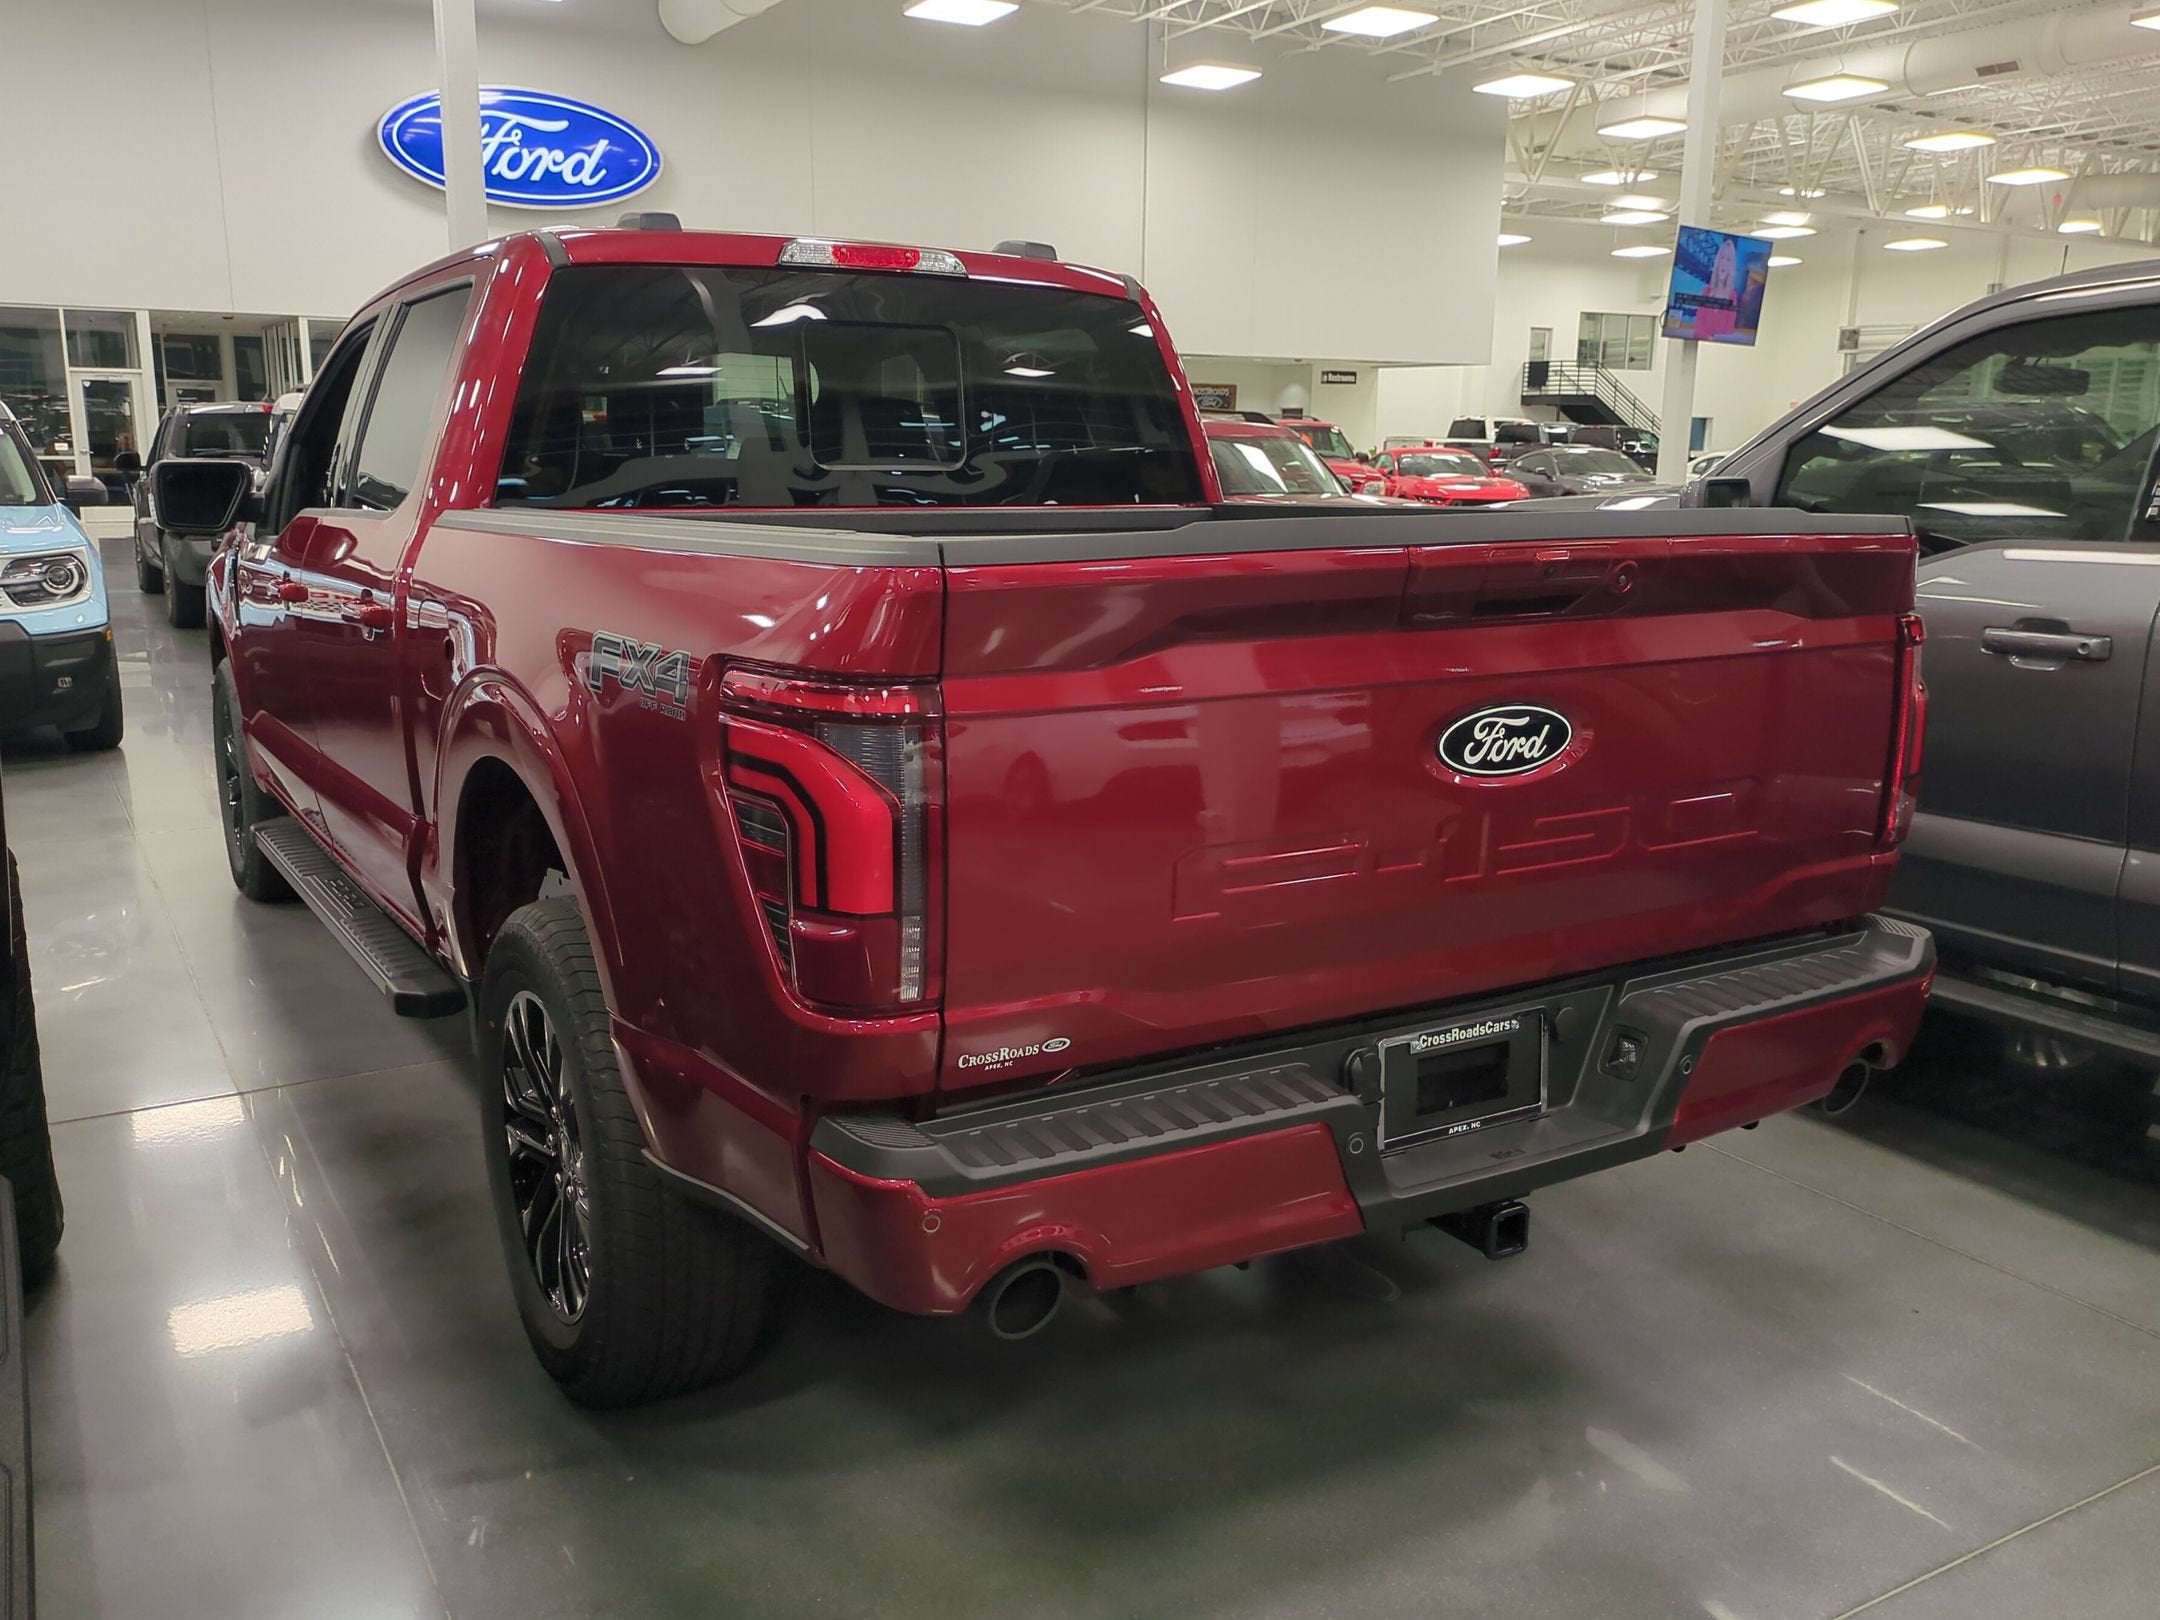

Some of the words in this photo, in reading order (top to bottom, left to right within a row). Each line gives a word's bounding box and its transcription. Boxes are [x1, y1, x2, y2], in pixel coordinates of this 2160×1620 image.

[589, 629, 691, 708] FX4
[1463, 715, 1551, 765] Ford
[1420, 1020, 1511, 1049] CrossRoadsCars
[1470, 1121, 1481, 1129] NC
